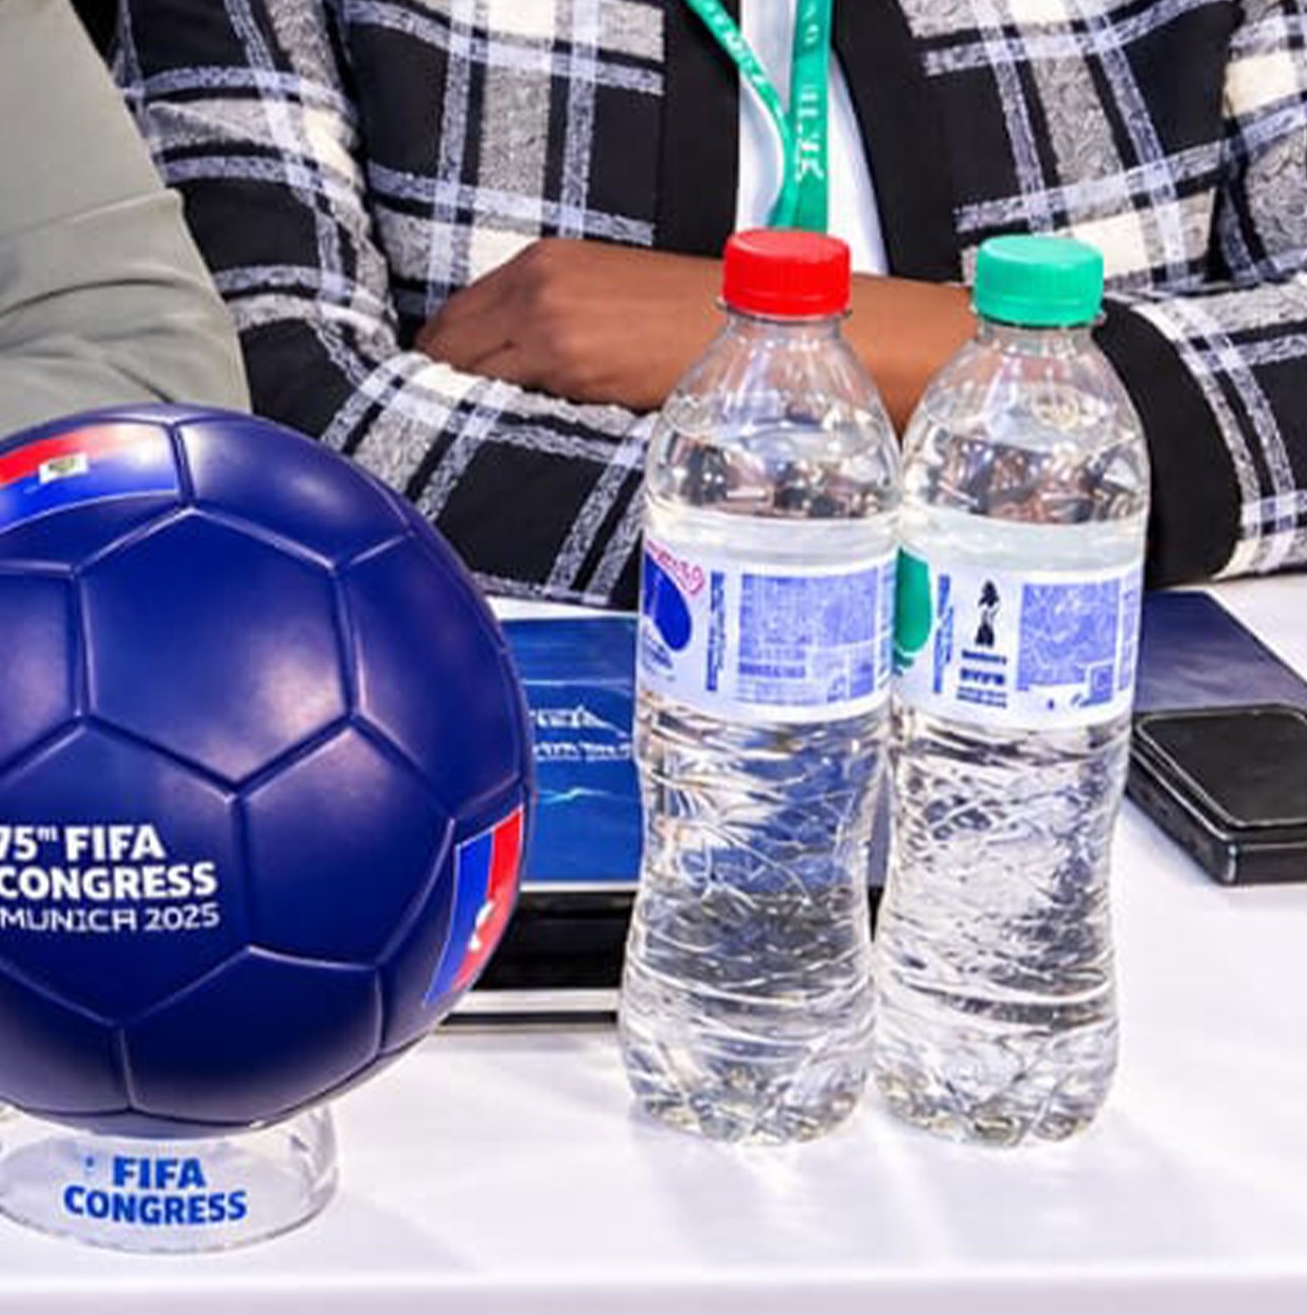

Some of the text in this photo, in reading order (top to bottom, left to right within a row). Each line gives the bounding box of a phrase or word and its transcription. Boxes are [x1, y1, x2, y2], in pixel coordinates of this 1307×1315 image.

[64, 823, 167, 862] FIFA
[144, 902, 221, 932] 2025
[112, 1155, 207, 1190] FIFA
[63, 1184, 248, 1226] CONGRESS
